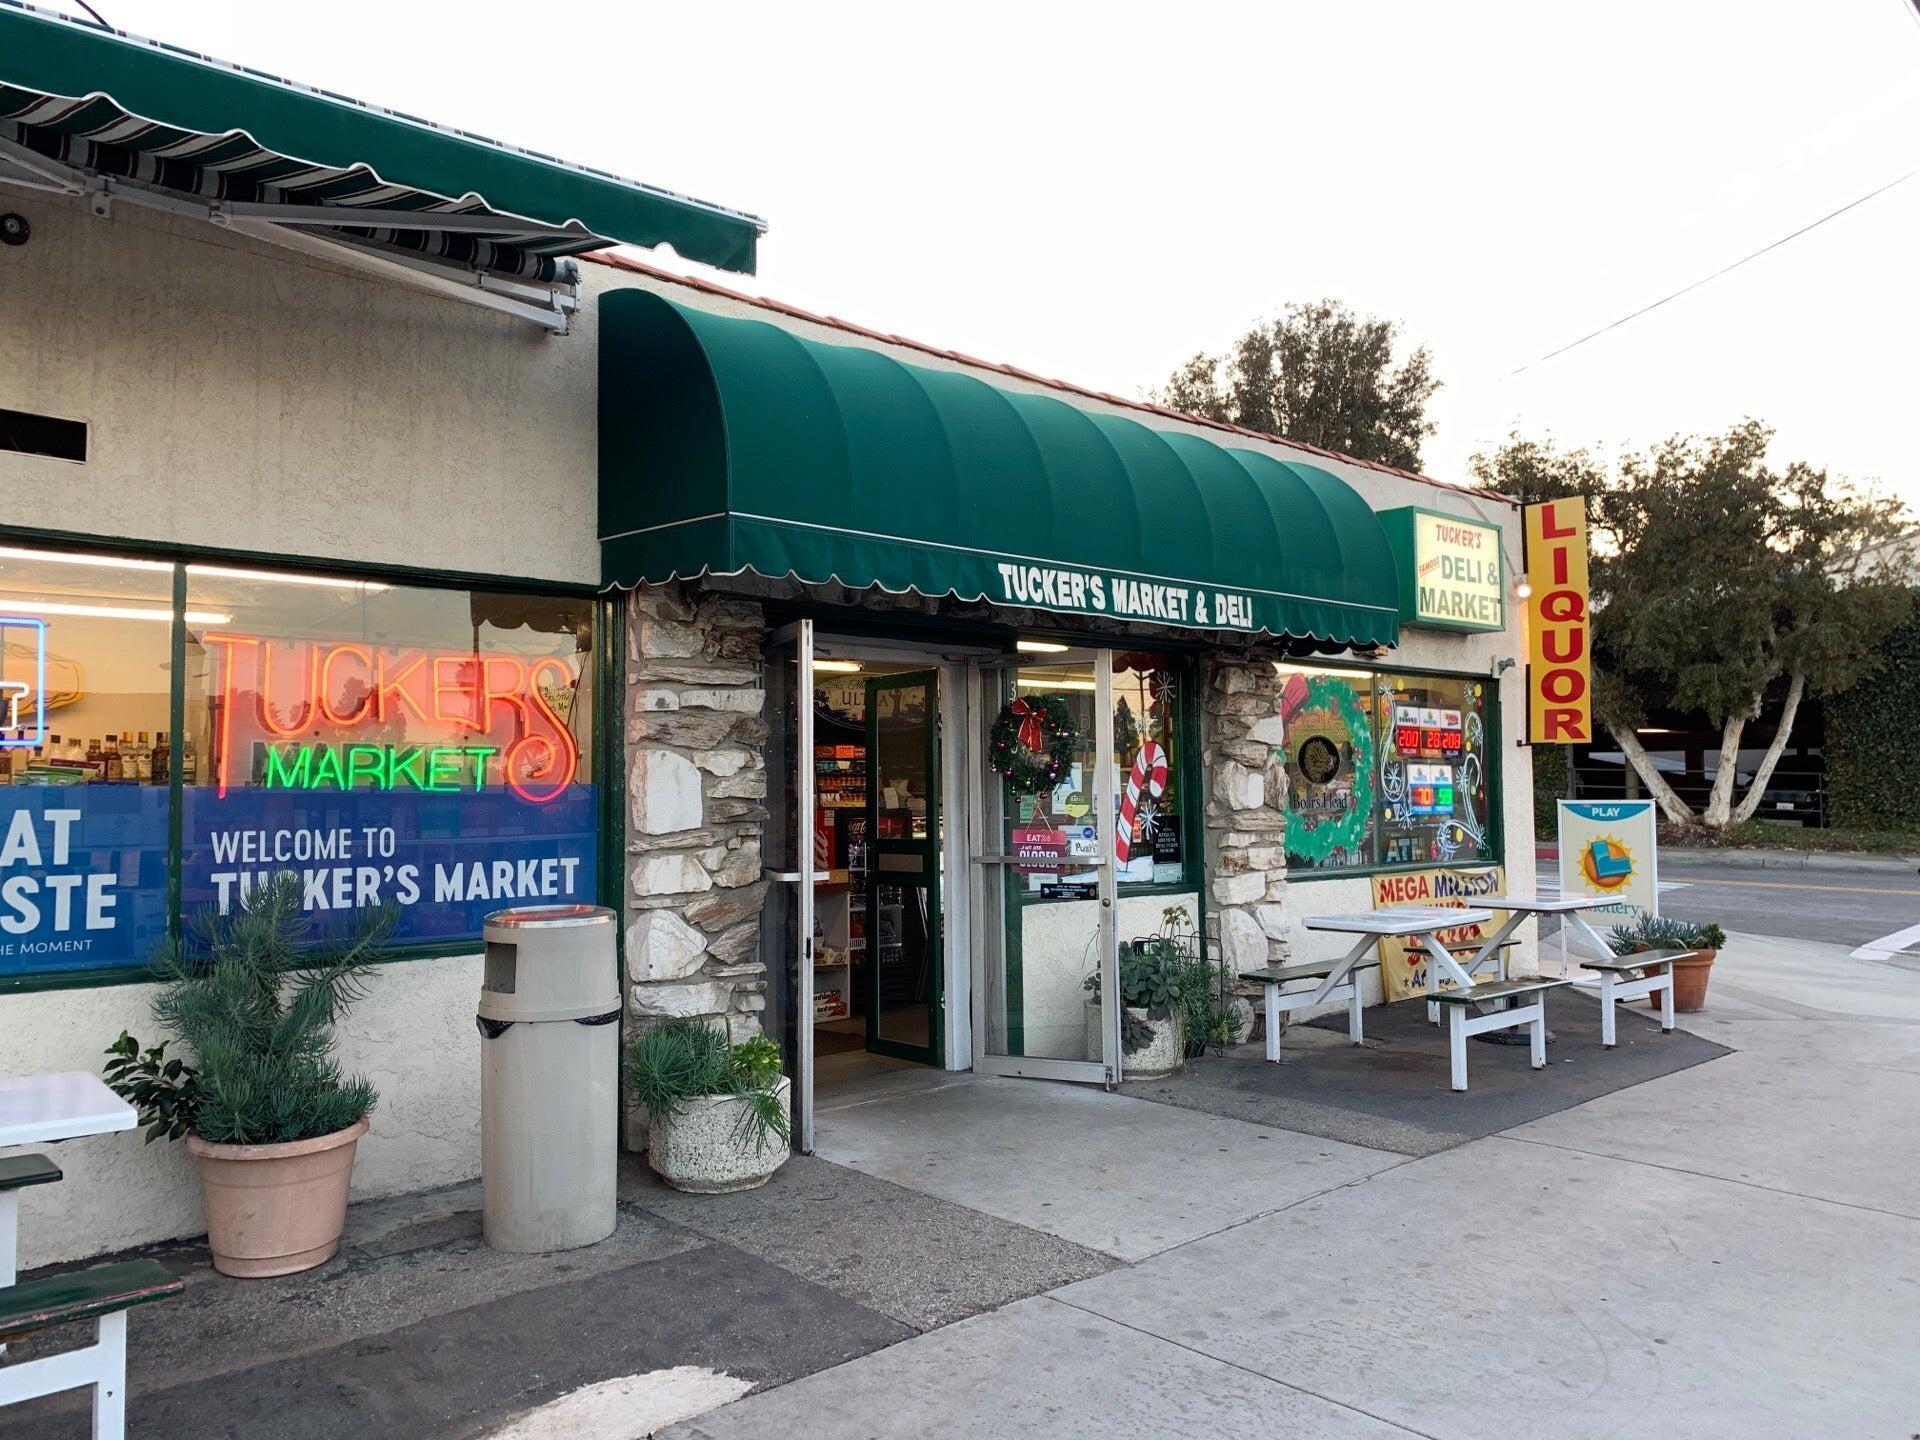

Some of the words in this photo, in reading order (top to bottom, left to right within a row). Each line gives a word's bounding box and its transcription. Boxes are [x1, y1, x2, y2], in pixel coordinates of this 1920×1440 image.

[1436, 524, 1482, 549] TUCKER'S
[1441, 555, 1482, 584] DELI
[1487, 562, 1499, 586] &
[998, 563, 1106, 611] TUCKER'S
[1111, 578, 1188, 621] MARKET
[1194, 590, 1209, 624] &
[1215, 593, 1252, 628] DELI
[1419, 586, 1500, 622] MARKET
[1540, 504, 1586, 740] LIQUOR
[203, 633, 577, 803] TUCKERS
[267, 745, 497, 793] MARKET
[1293, 793, 1321, 809] Boar's
[1323, 793, 1348, 809] Head
[1592, 807, 1620, 817] PLAY
[211, 829, 352, 864] WELCOME
[363, 827, 395, 858] TO
[434, 857, 580, 903] MARKET
[1380, 875, 1430, 903] MEGA
[20, 939, 93, 954] MOMENT
